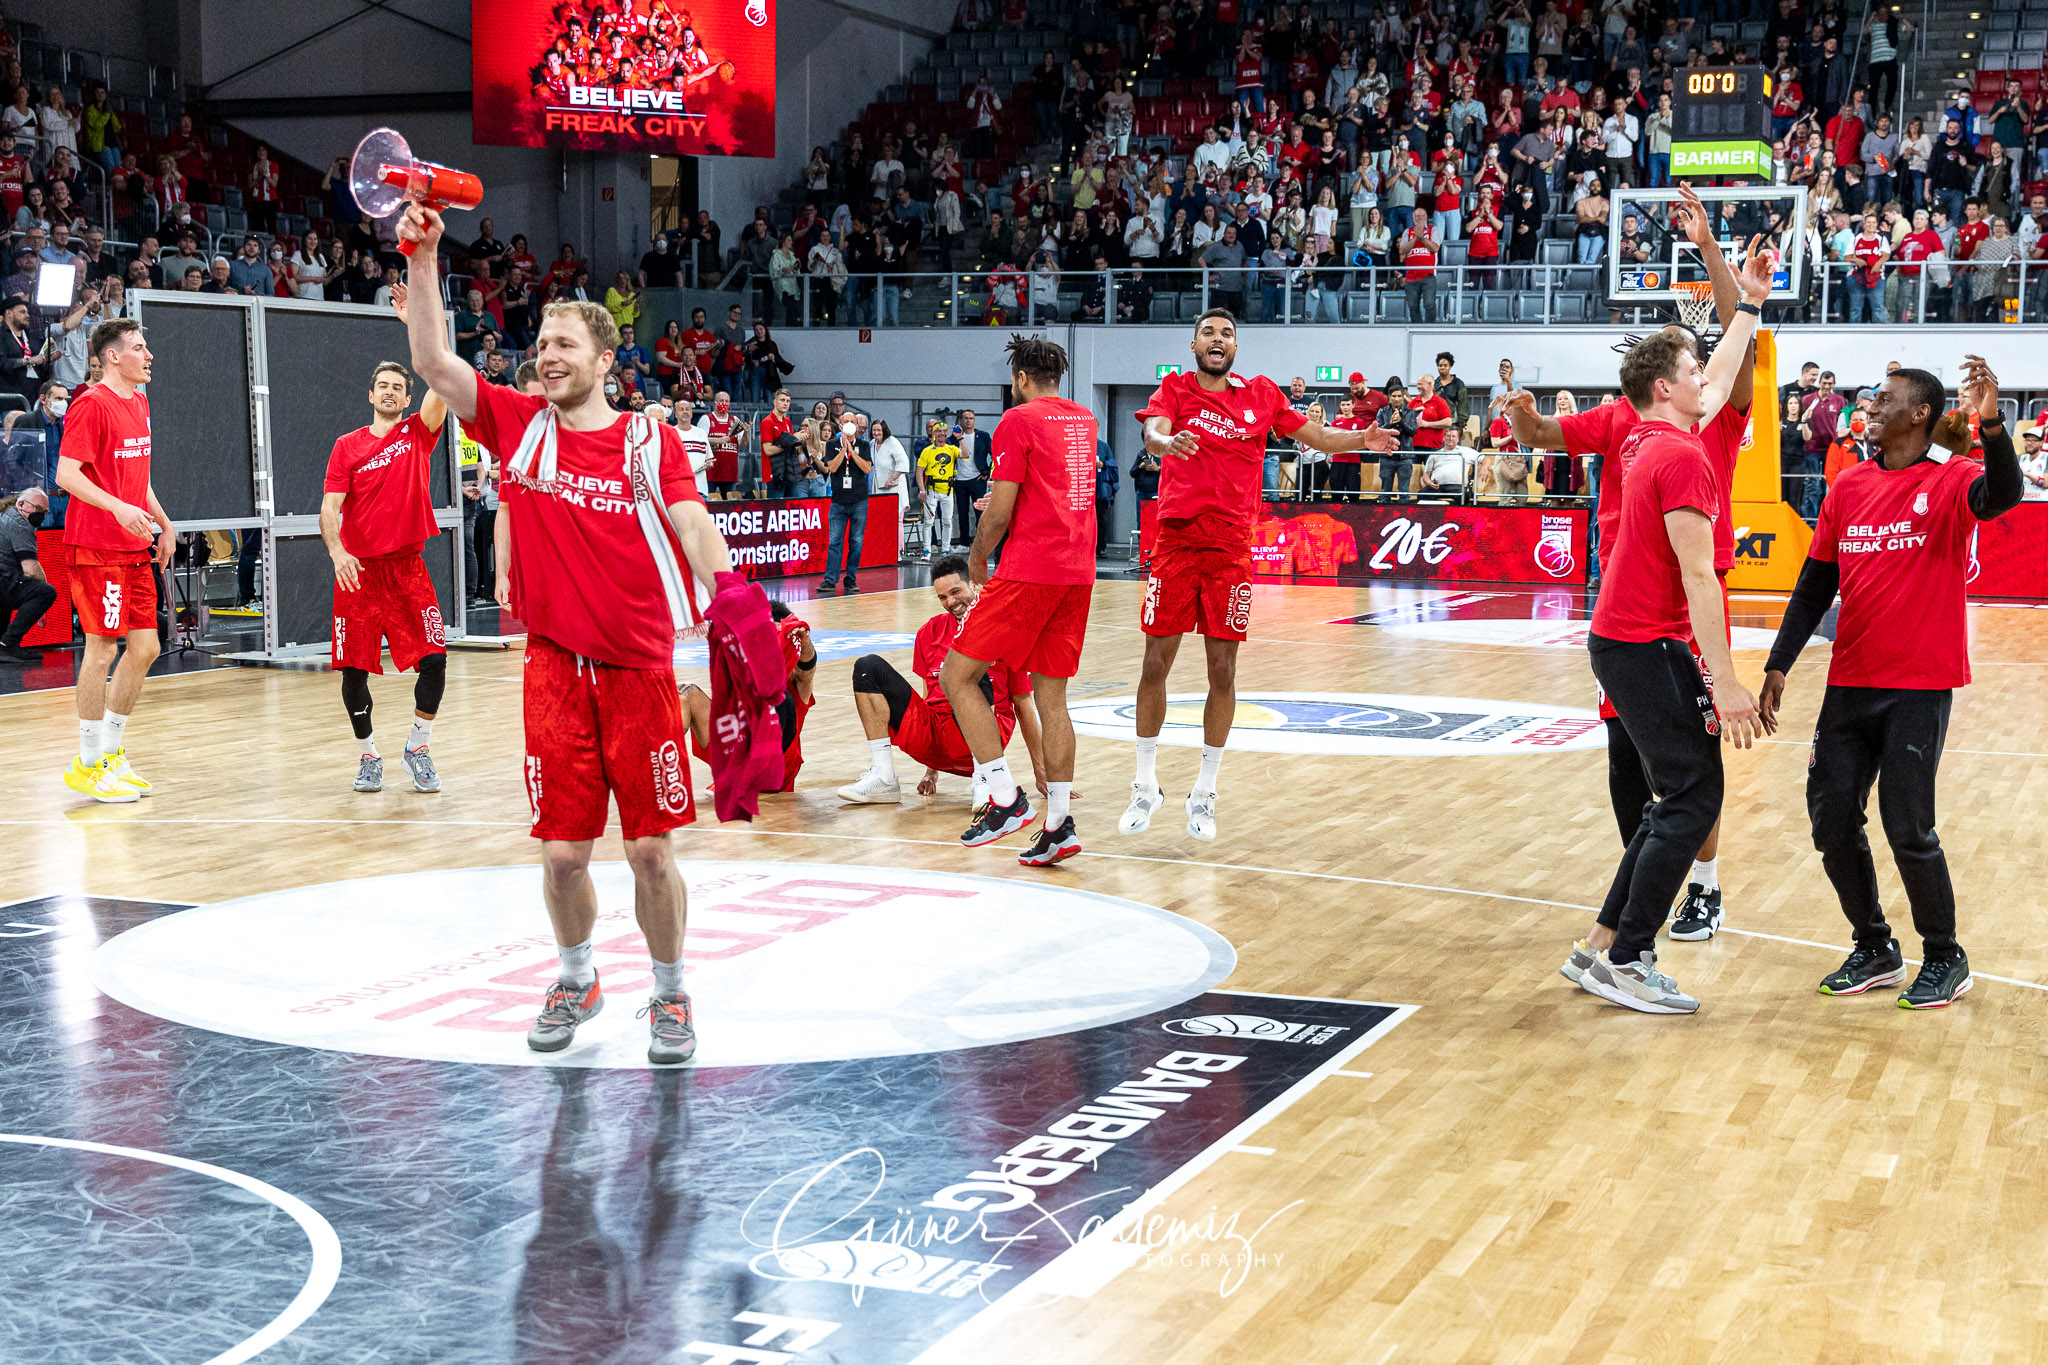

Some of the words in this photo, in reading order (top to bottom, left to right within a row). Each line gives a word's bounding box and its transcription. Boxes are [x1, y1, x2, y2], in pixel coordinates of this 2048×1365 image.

[569, 86, 684, 111] BELIEVE
[545, 112, 638, 135] FREAK
[644, 116, 708, 137] CITY
[621, 108, 632, 116] IN
[1673, 149, 1756, 167] BARMER
[1621, 280, 1640, 288] BBL
[1187, 417, 1228, 439] FREAK
[114, 449, 142, 459] FREAK
[558, 470, 623, 495] ELIEVE
[591, 497, 635, 515] CITY
[710, 511, 764, 536] ROSE
[766, 508, 822, 533] ARENA
[1541, 514, 1573, 524] brose
[1846, 521, 1912, 538] BELIEVE
[726, 538, 810, 567] ornstraße
[1369, 517, 1460, 570] 20€
[1734, 532, 1777, 560] XT
[1838, 540, 1883, 553] FREAK
[1887, 535, 1928, 551] CITY
[1266, 553, 1286, 561] CITY
[102, 580, 122, 630] SIXT
[1143, 572, 1158, 626] SIXT
[1225, 584, 1236, 626] AUTOMATION
[1696, 694, 1709, 708] PH
[650, 750, 665, 811] AUTOMATION
[920, 1050, 1249, 1214] BAMBERG
